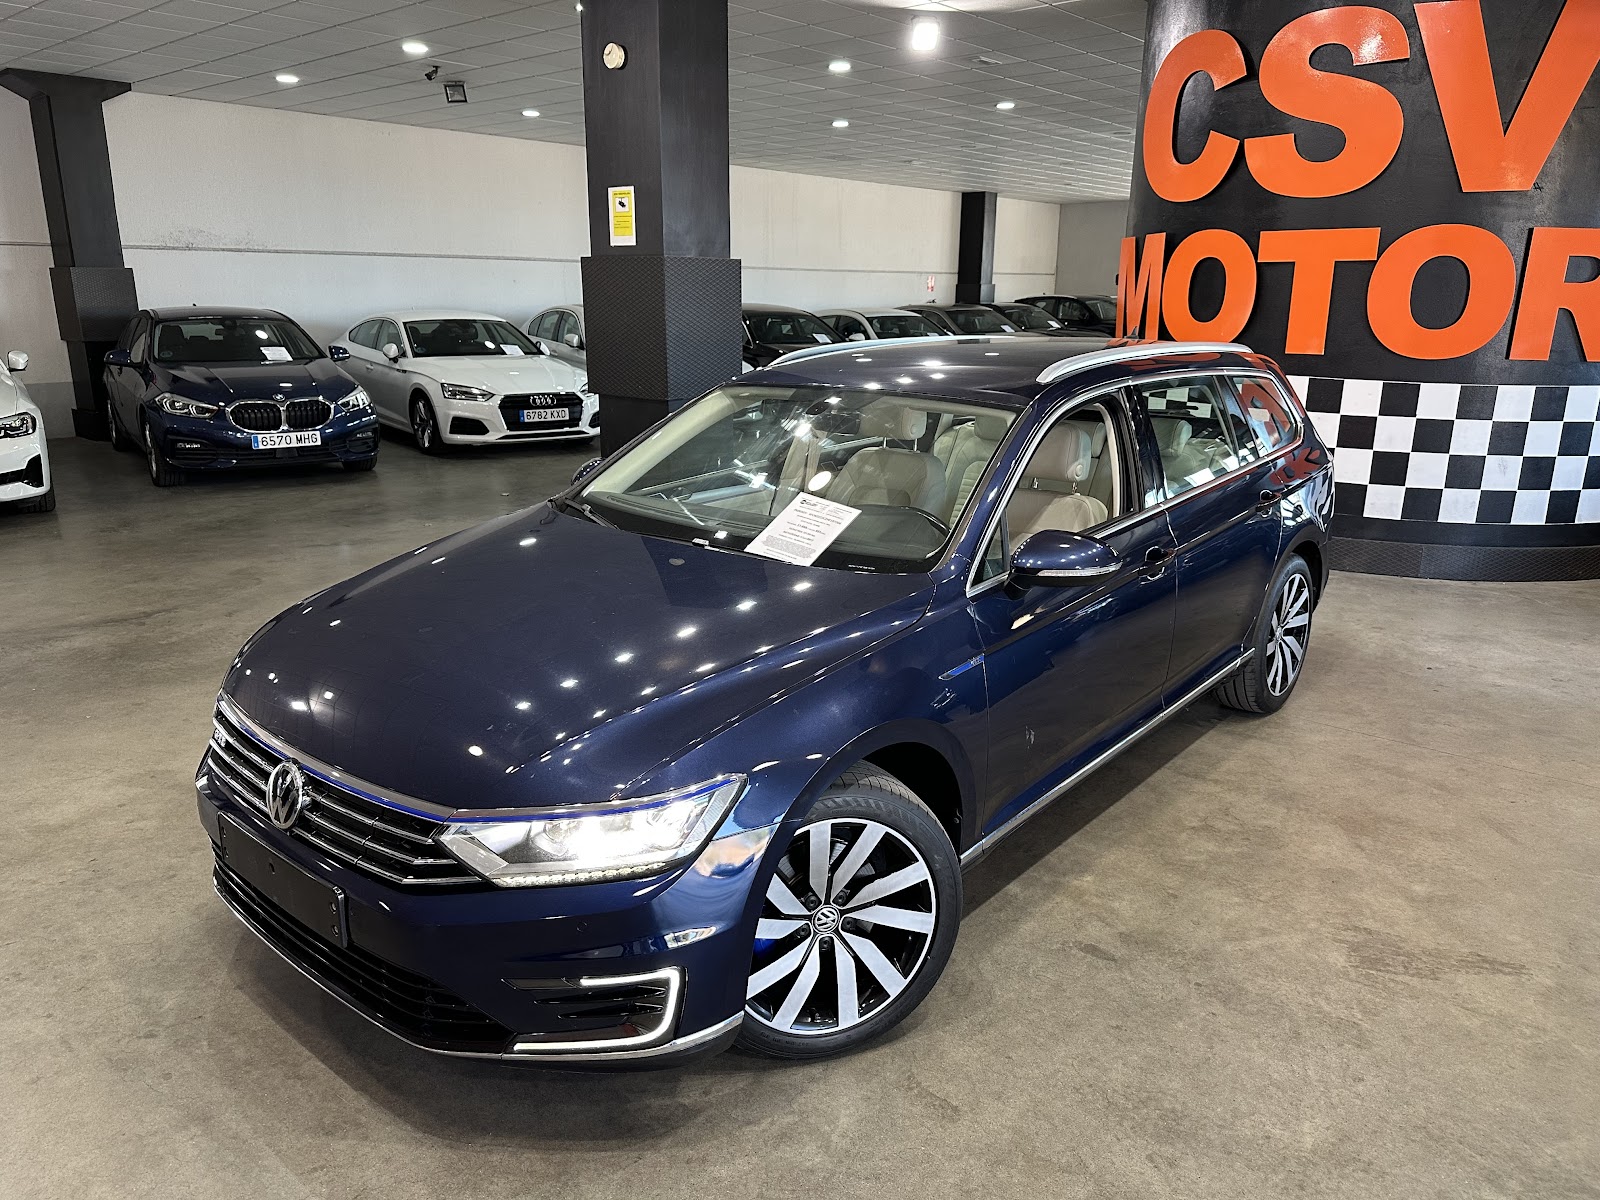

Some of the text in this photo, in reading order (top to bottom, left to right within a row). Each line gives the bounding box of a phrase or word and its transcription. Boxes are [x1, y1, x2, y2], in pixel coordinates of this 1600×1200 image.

[1143, 0, 1600, 202] CSV
[1116, 224, 1600, 362] MOTOR
[261, 433, 318, 447] 6570 MHG
